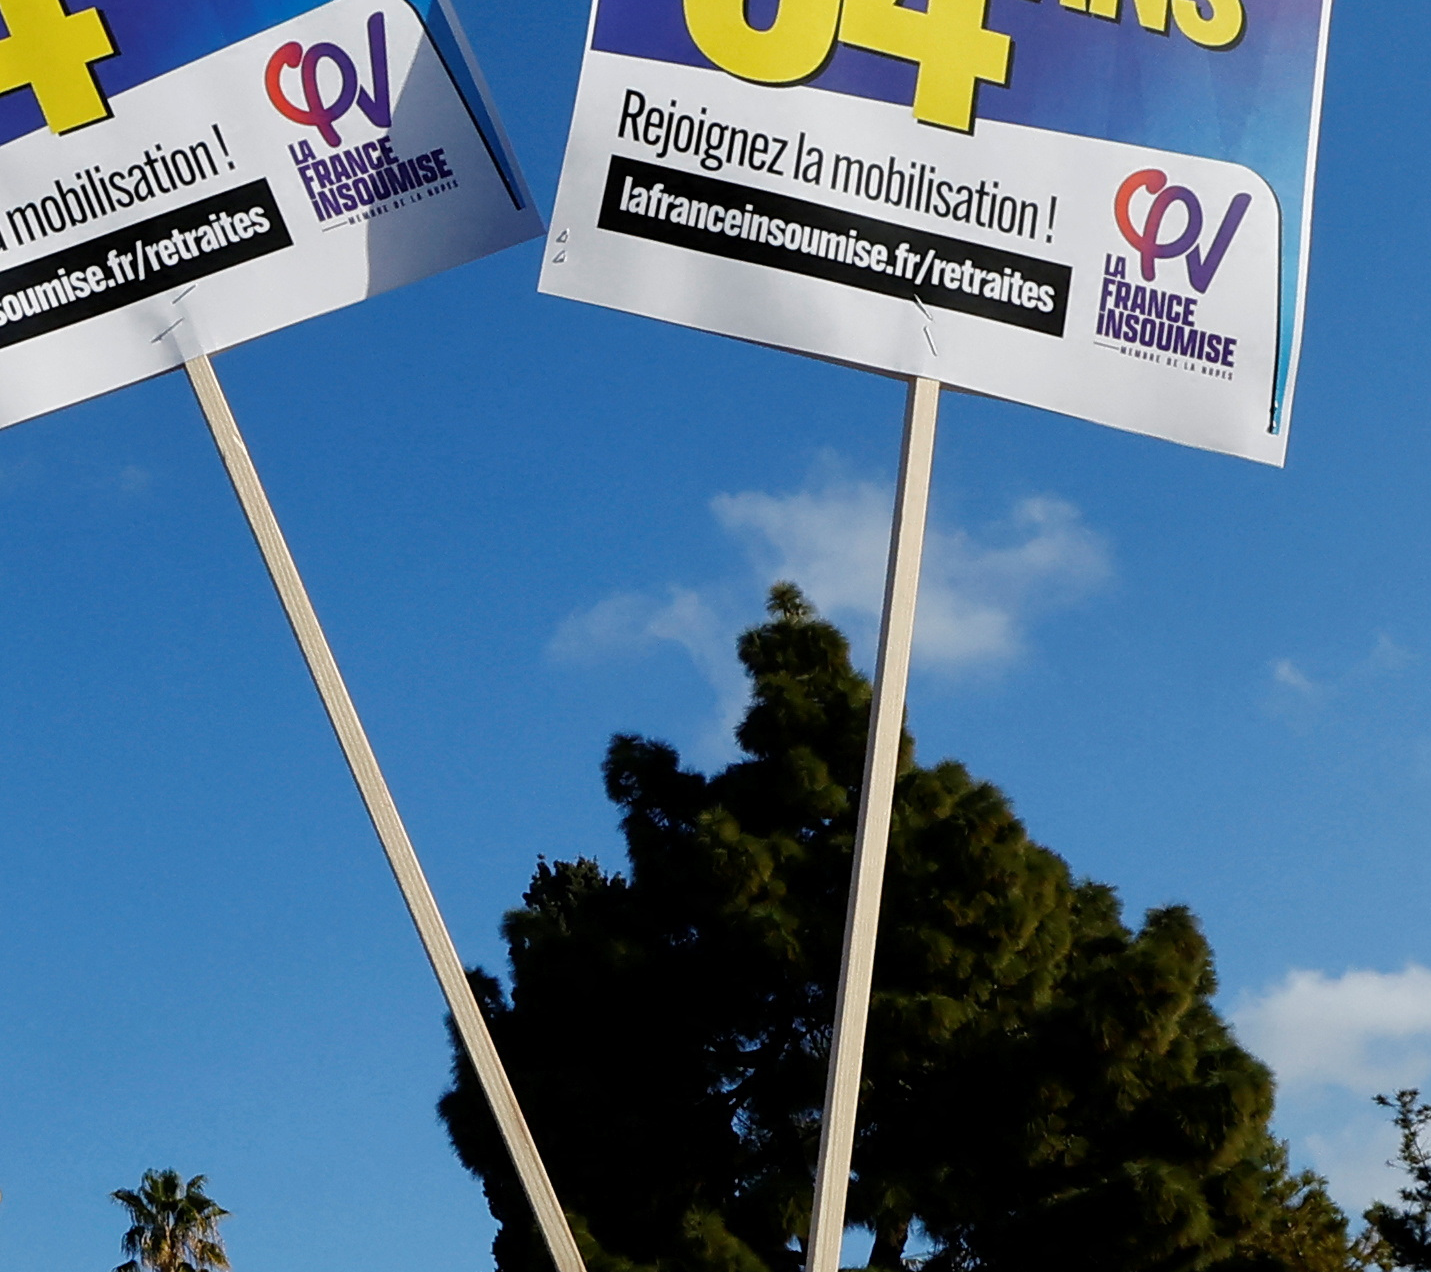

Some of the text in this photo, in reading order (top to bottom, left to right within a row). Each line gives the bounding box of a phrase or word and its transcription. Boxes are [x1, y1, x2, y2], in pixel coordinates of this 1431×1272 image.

[288, 139, 316, 166] LA
[298, 135, 399, 200] FRANCE
[618, 89, 788, 175] Rejoignez
[793, 132, 824, 185] la
[313, 148, 453, 222] INSOUMISE
[620, 176, 1054, 313] lafranceinsoumise.fr/retraites
[1104, 253, 1126, 280] LA
[1099, 277, 1197, 327] FRANCE
[1096, 308, 1237, 367] INSOUMISE
